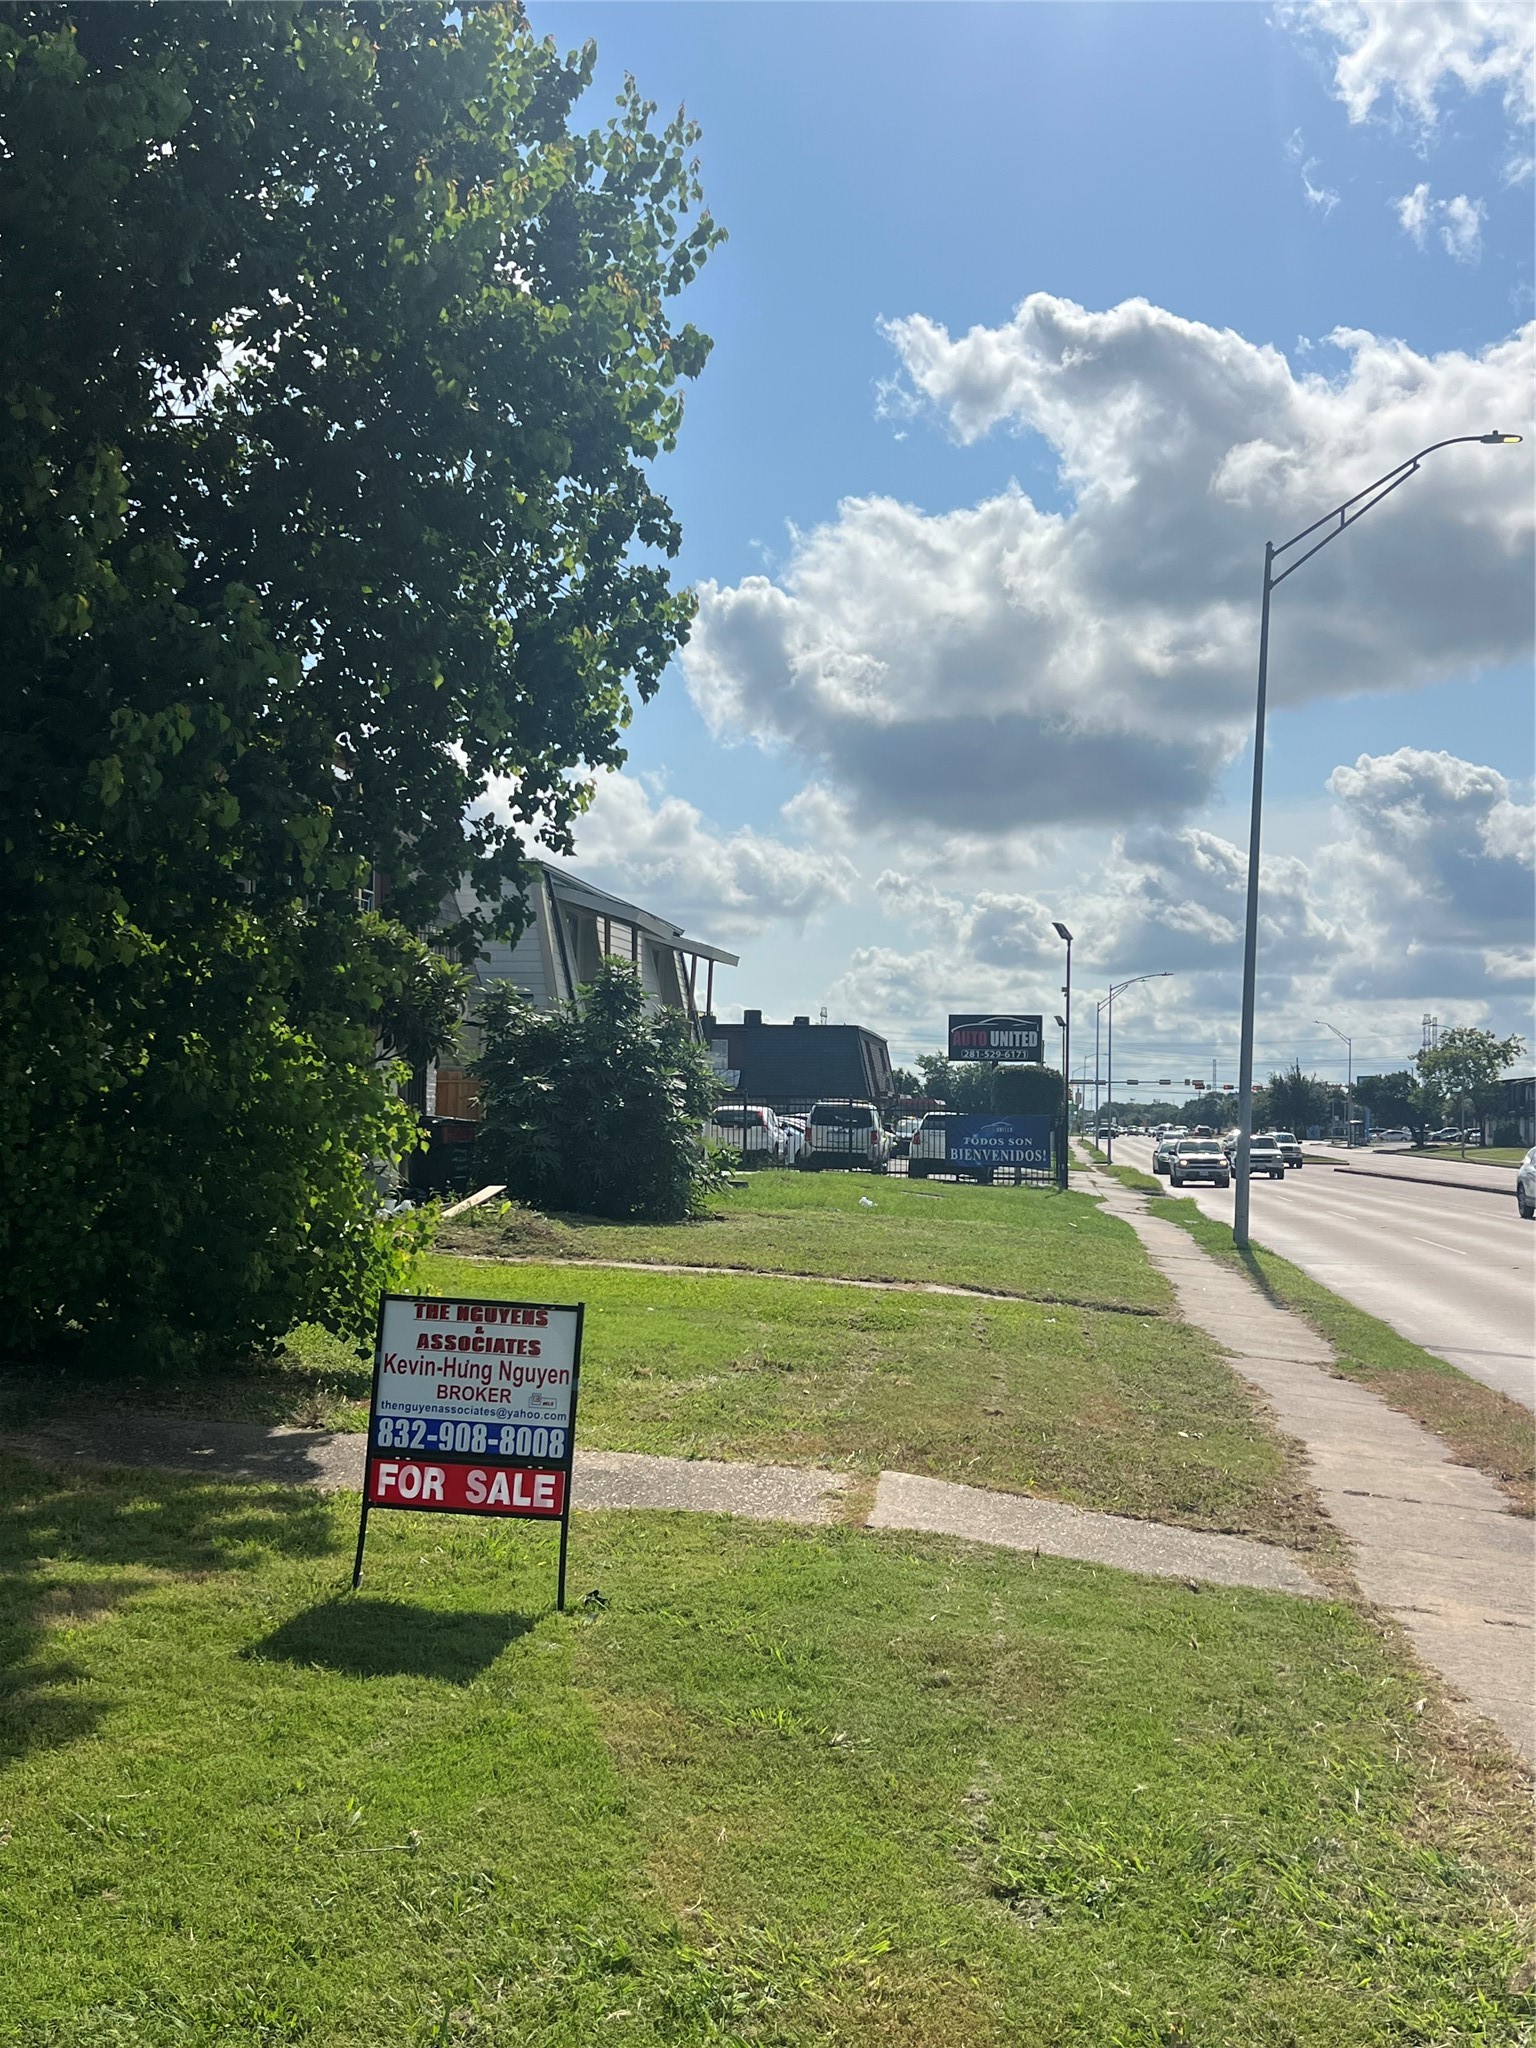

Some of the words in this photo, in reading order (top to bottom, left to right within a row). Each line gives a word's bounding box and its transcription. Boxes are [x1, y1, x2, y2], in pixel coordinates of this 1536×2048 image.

[953, 1031, 987, 1047] AUTO
[990, 1031, 1038, 1047] UNITED
[963, 1050, 1026, 1059] 281-529-6171
[963, 1137, 1005, 1145] TODOS
[1008, 1137, 1033, 1146] SON
[950, 1148, 1047, 1162] BIENVENIDOS!
[414, 1303, 450, 1320] THE
[457, 1305, 549, 1327] NGUYENS
[475, 1326, 484, 1334] &
[416, 1333, 541, 1356] ASSOCIATES
[499, 1360, 570, 1389] Nguyen
[436, 1384, 512, 1404] BROKER
[381, 1399, 567, 1422] thenguyenassociates@yahoo.com
[378, 1418, 565, 1459] 832-908-8008
[377, 1463, 446, 1501] FOR
[465, 1469, 556, 1508] SALE
